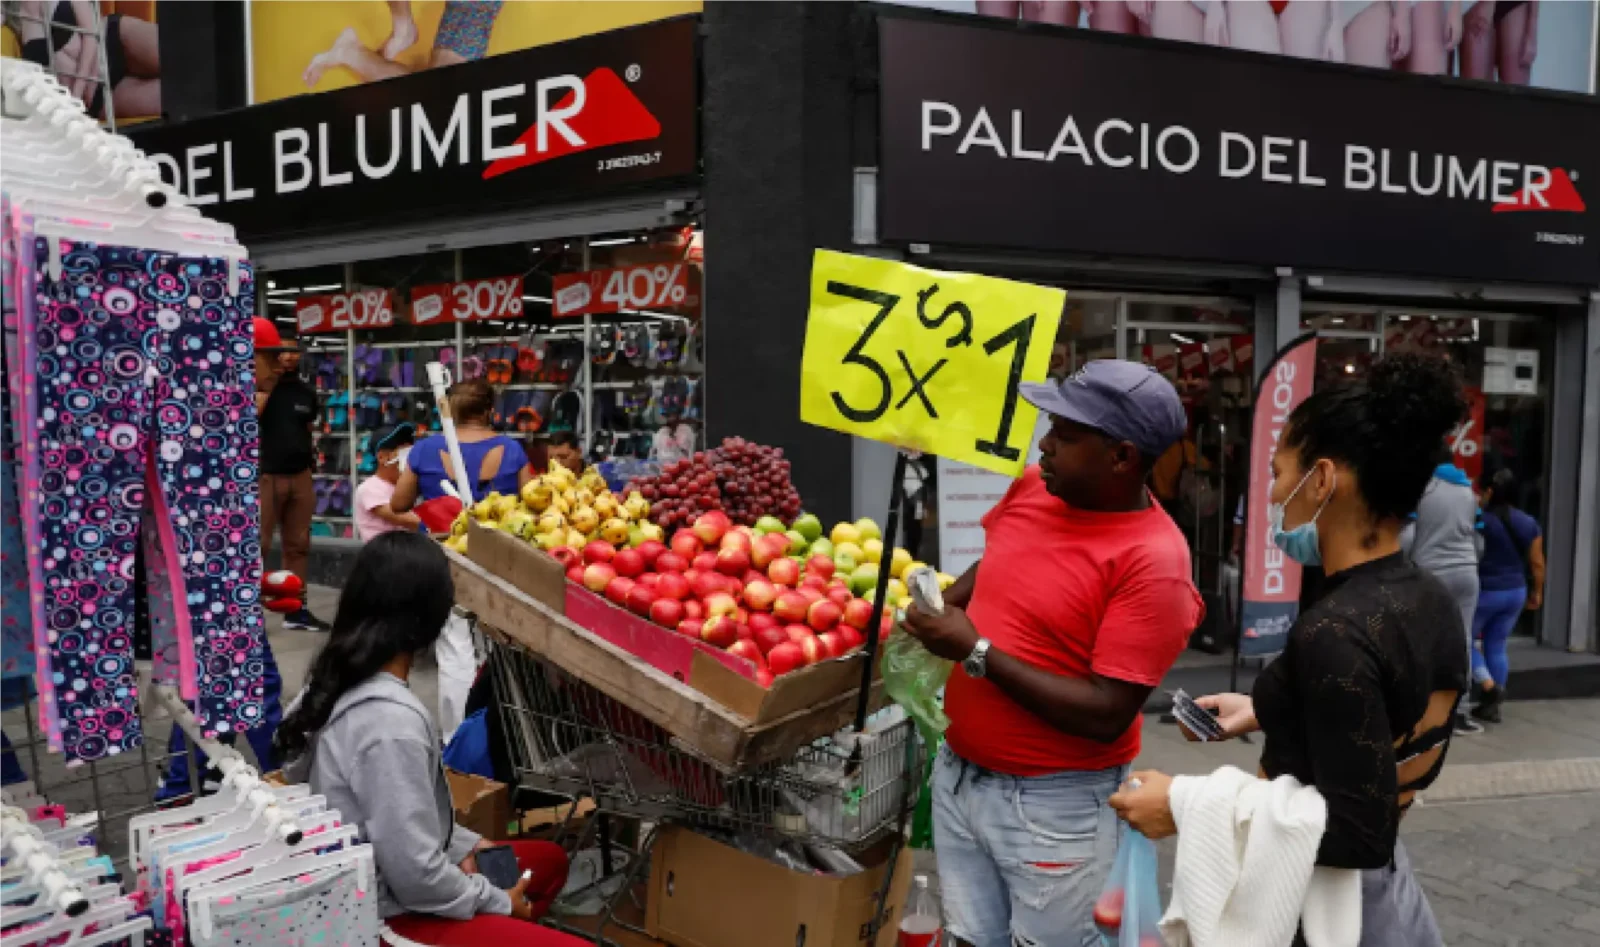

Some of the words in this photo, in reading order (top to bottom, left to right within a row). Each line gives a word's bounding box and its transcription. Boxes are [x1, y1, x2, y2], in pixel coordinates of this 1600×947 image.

[274, 74, 587, 194] BLUMER
[921, 100, 1200, 173] PALACIO
[1219, 131, 1326, 187] DEL
[1344, 144, 1551, 207] BLUMER
[331, 288, 392, 328] 20%
[452, 277, 522, 319] 30%
[601, 264, 685, 309] 40%
[826, 280, 901, 422] 3
